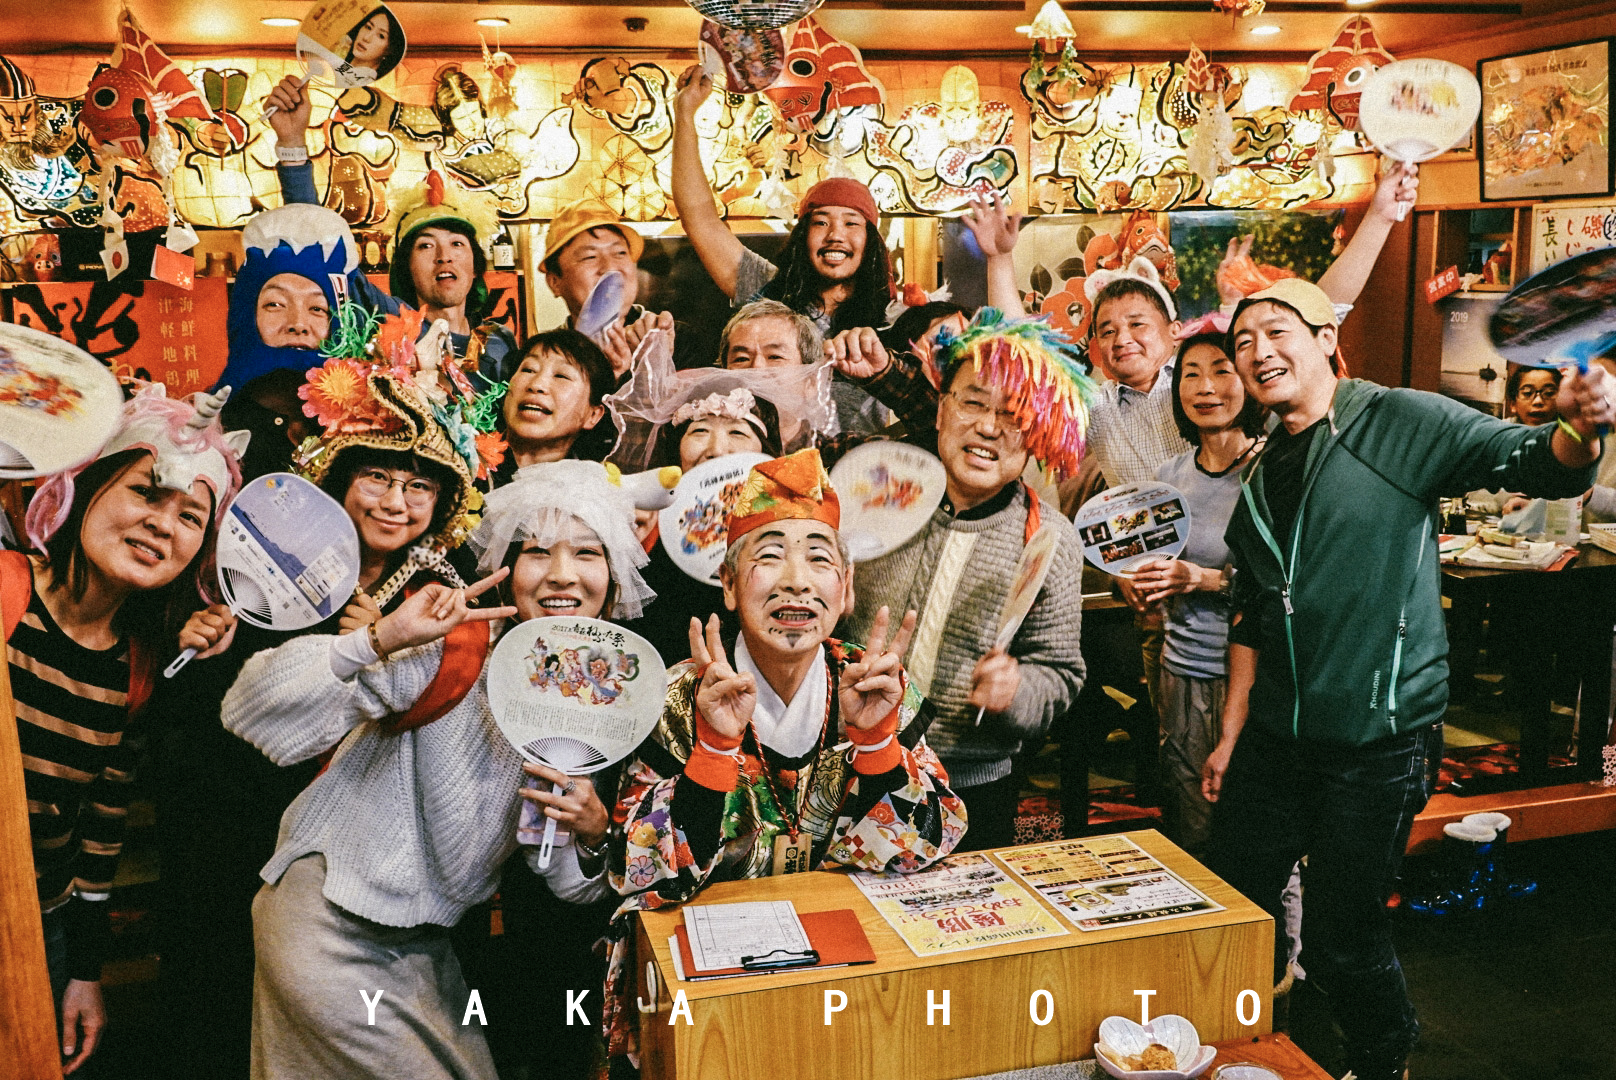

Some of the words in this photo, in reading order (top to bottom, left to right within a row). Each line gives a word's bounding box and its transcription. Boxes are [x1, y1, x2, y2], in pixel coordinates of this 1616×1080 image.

[1428, 271, 1455, 294] 営業中
[1450, 311, 1469, 323] 2019
[1371, 670, 1381, 702] HOUDINI
[935, 911, 1006, 934] 優勝
